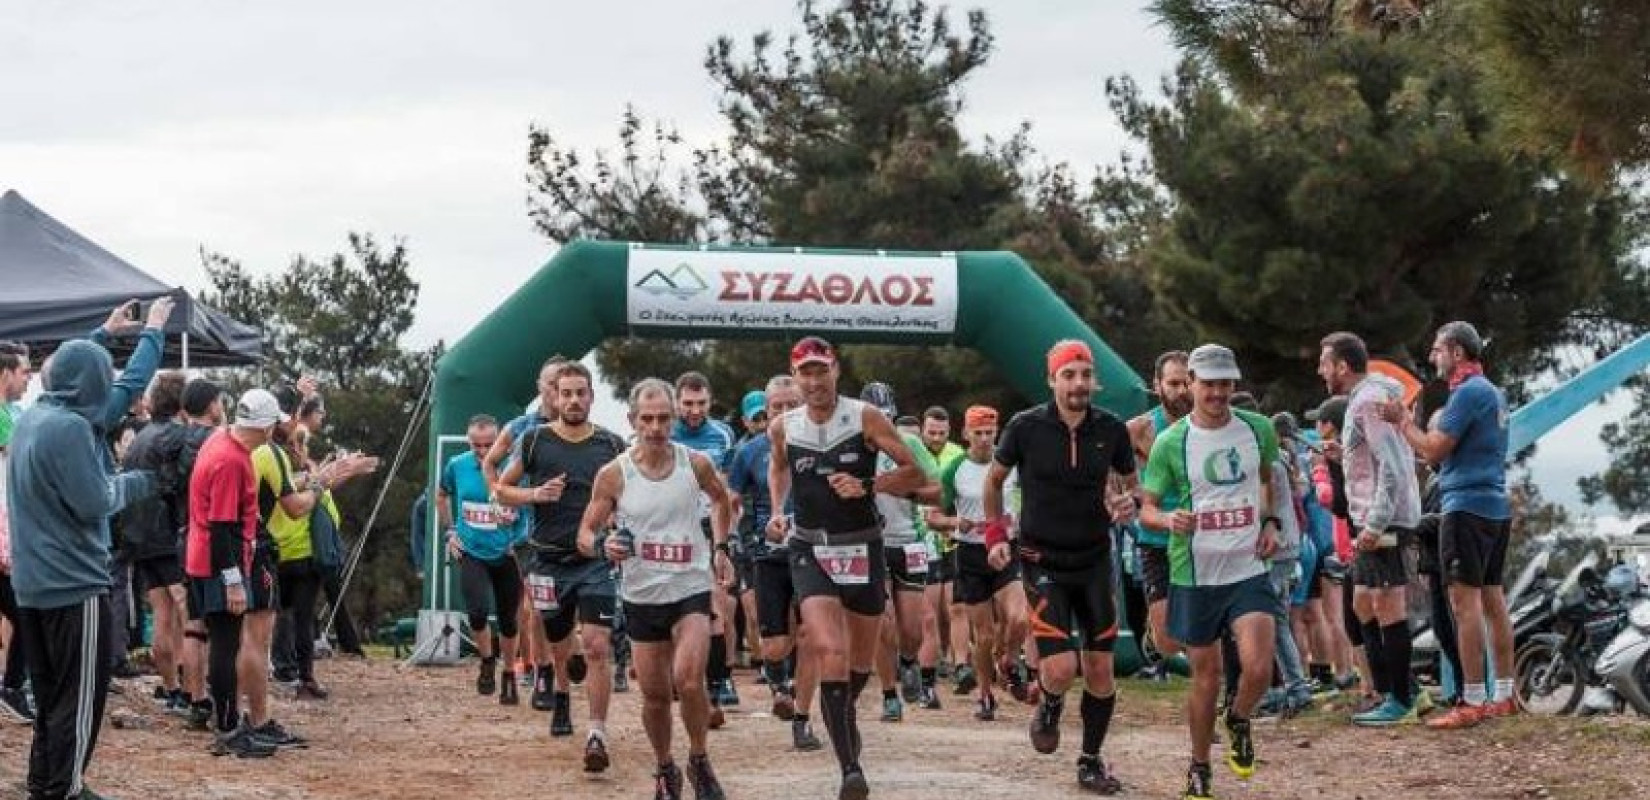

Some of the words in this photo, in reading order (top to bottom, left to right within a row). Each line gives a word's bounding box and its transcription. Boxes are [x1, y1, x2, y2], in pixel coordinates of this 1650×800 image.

[718, 271, 935, 306] ΣΥΖΑΘΛΟΣ
[1213, 509, 1246, 528] 135
[654, 545, 685, 561] 131
